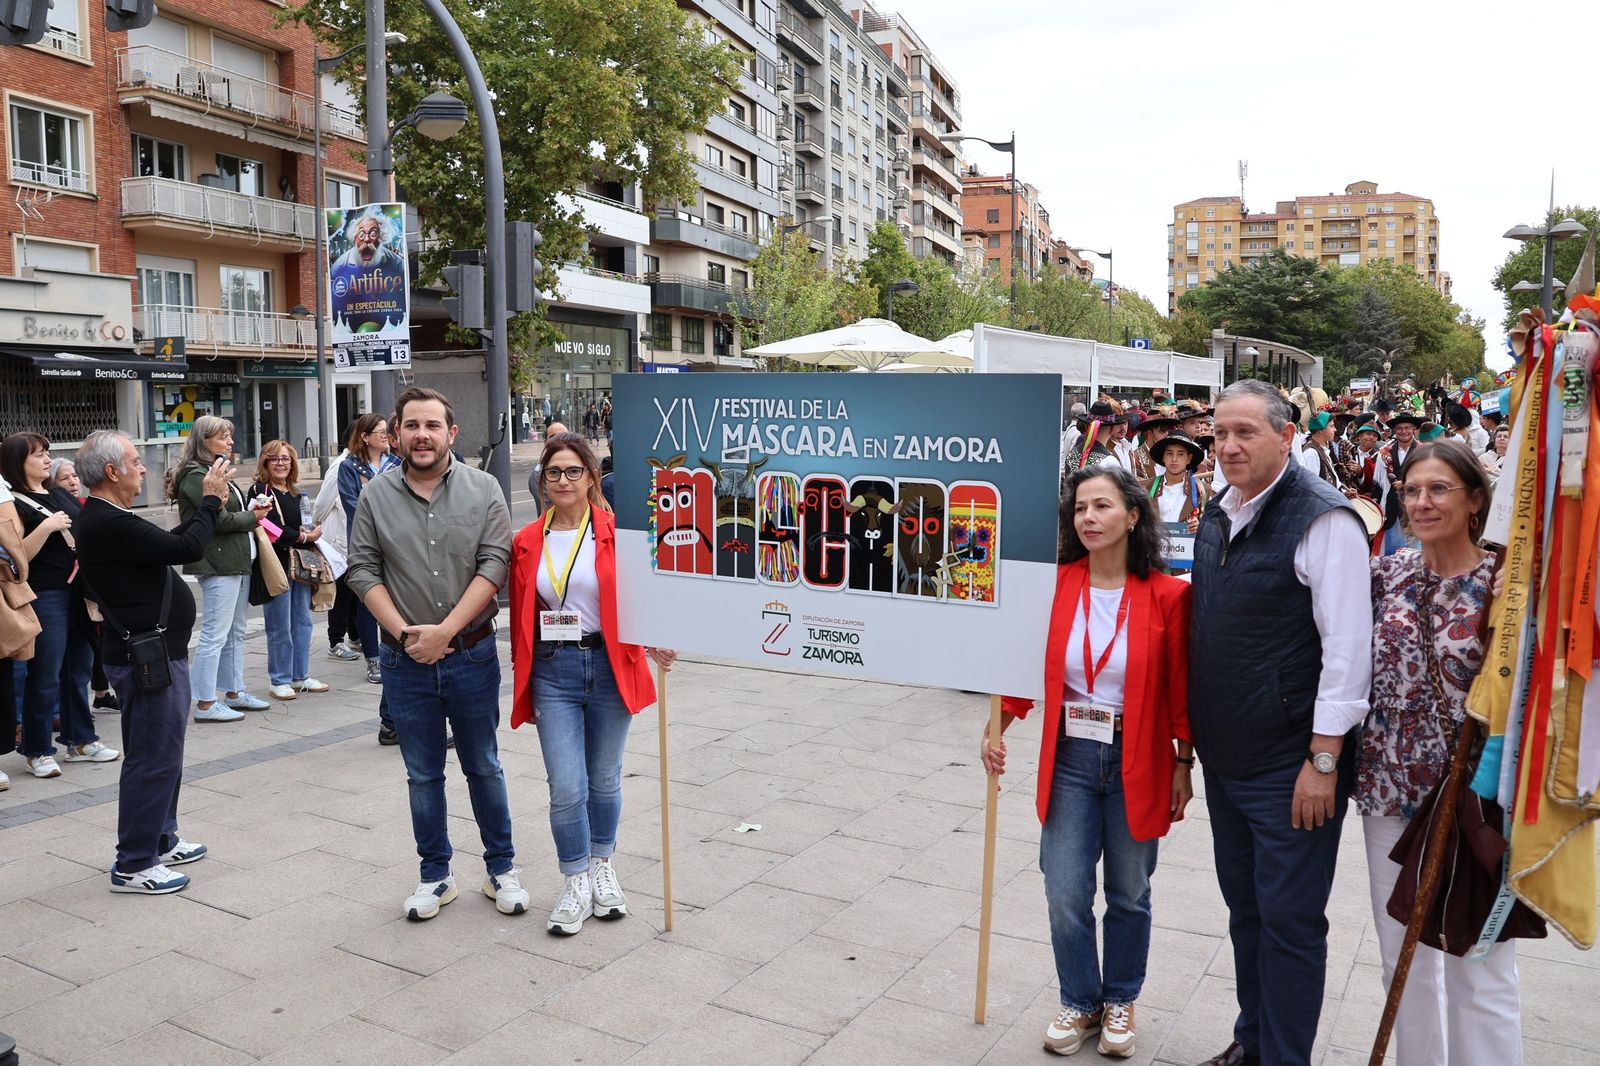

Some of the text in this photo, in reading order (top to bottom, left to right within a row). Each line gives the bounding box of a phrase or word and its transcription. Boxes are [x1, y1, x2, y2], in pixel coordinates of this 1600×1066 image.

[349, 268, 402, 294] Artifice
[24, 315, 79, 338] Benito
[100, 321, 126, 341] Co
[338, 354, 345, 363] 3
[394, 350, 406, 359] 13
[554, 341, 611, 356] NUEVO SIGLO
[95, 368, 138, 379] Benito&Co
[722, 398, 849, 420] FESTIVAL DE LA
[652, 397, 720, 452] XIV
[721, 418, 1003, 463] MÁSCARA EN ZAMORA
[1517, 458, 1537, 519] SENDIM
[1499, 535, 1527, 659] Festival de Folclore
[802, 614, 834, 623] DIPUTACIÓN
[841, 618, 865, 627] ZAMORA
[807, 627, 860, 645] TURISMO
[802, 645, 865, 667] ZAMORA
[1481, 901, 1506, 940] Rancho
